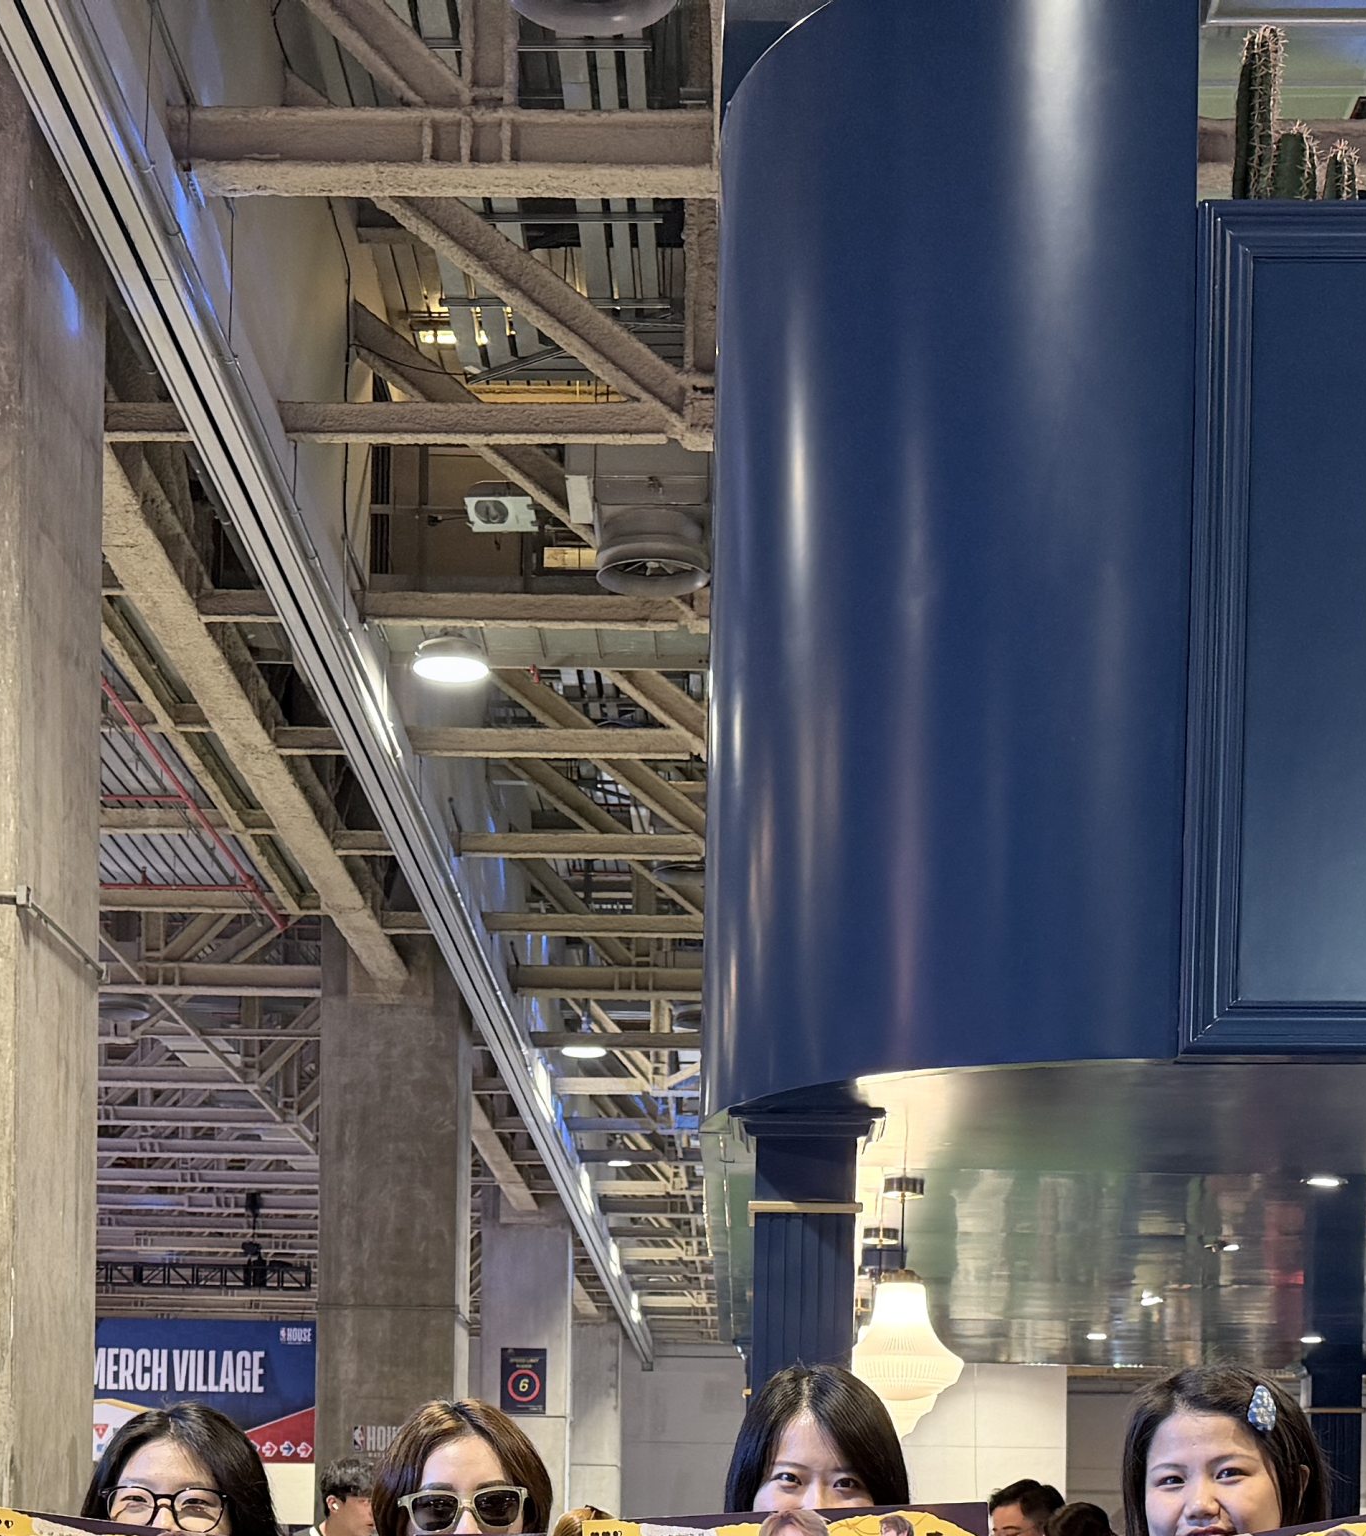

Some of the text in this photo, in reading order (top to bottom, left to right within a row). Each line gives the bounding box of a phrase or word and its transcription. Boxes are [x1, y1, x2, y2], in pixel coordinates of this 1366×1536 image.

[287, 1327, 312, 1342] HOUSE
[172, 1350, 266, 1394] VILLAGE
[519, 1379, 529, 1391] 6
